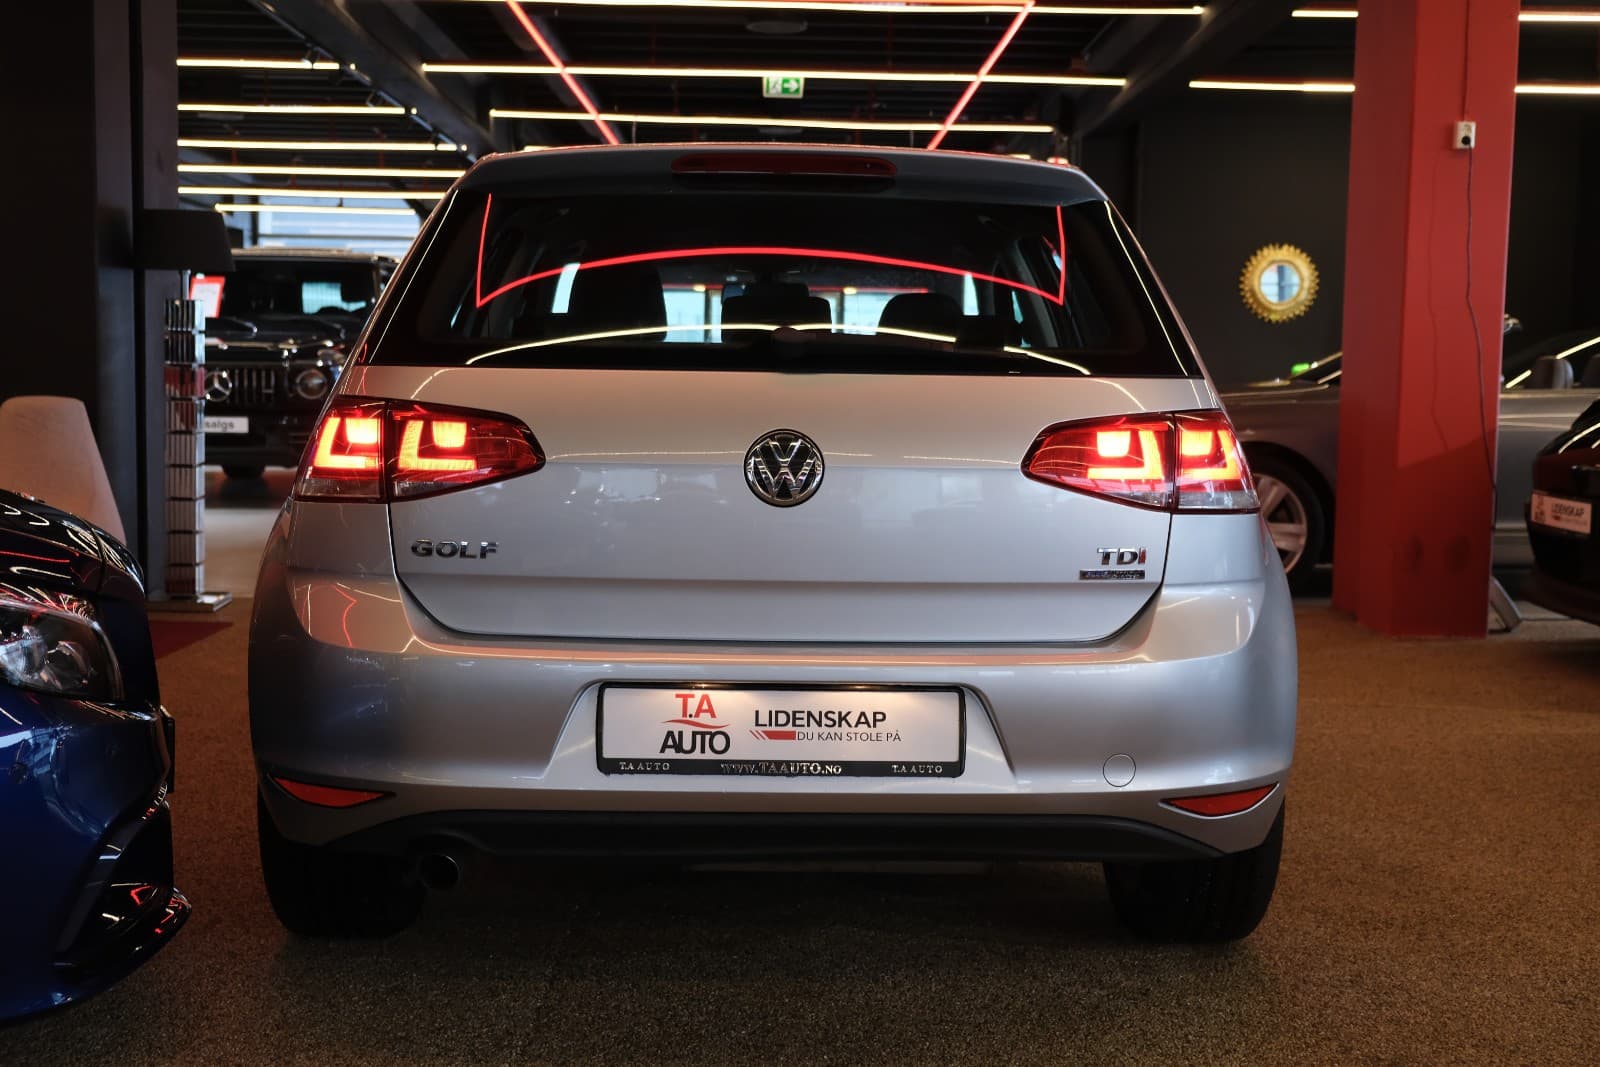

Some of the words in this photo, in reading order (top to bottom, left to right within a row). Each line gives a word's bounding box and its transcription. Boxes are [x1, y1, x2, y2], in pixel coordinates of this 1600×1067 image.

[410, 539, 497, 559] GOLF
[1097, 547, 1147, 566] TDI
[675, 693, 717, 719] T.A
[754, 709, 887, 729] LIDENSKAP
[659, 730, 731, 755] AUTO
[797, 731, 814, 742] DU
[818, 731, 843, 742] KAN
[846, 731, 883, 742] STOLE
[886, 729, 902, 742] PÅ
[636, 762, 671, 771] AUTO
[909, 765, 943, 774] AUTO
